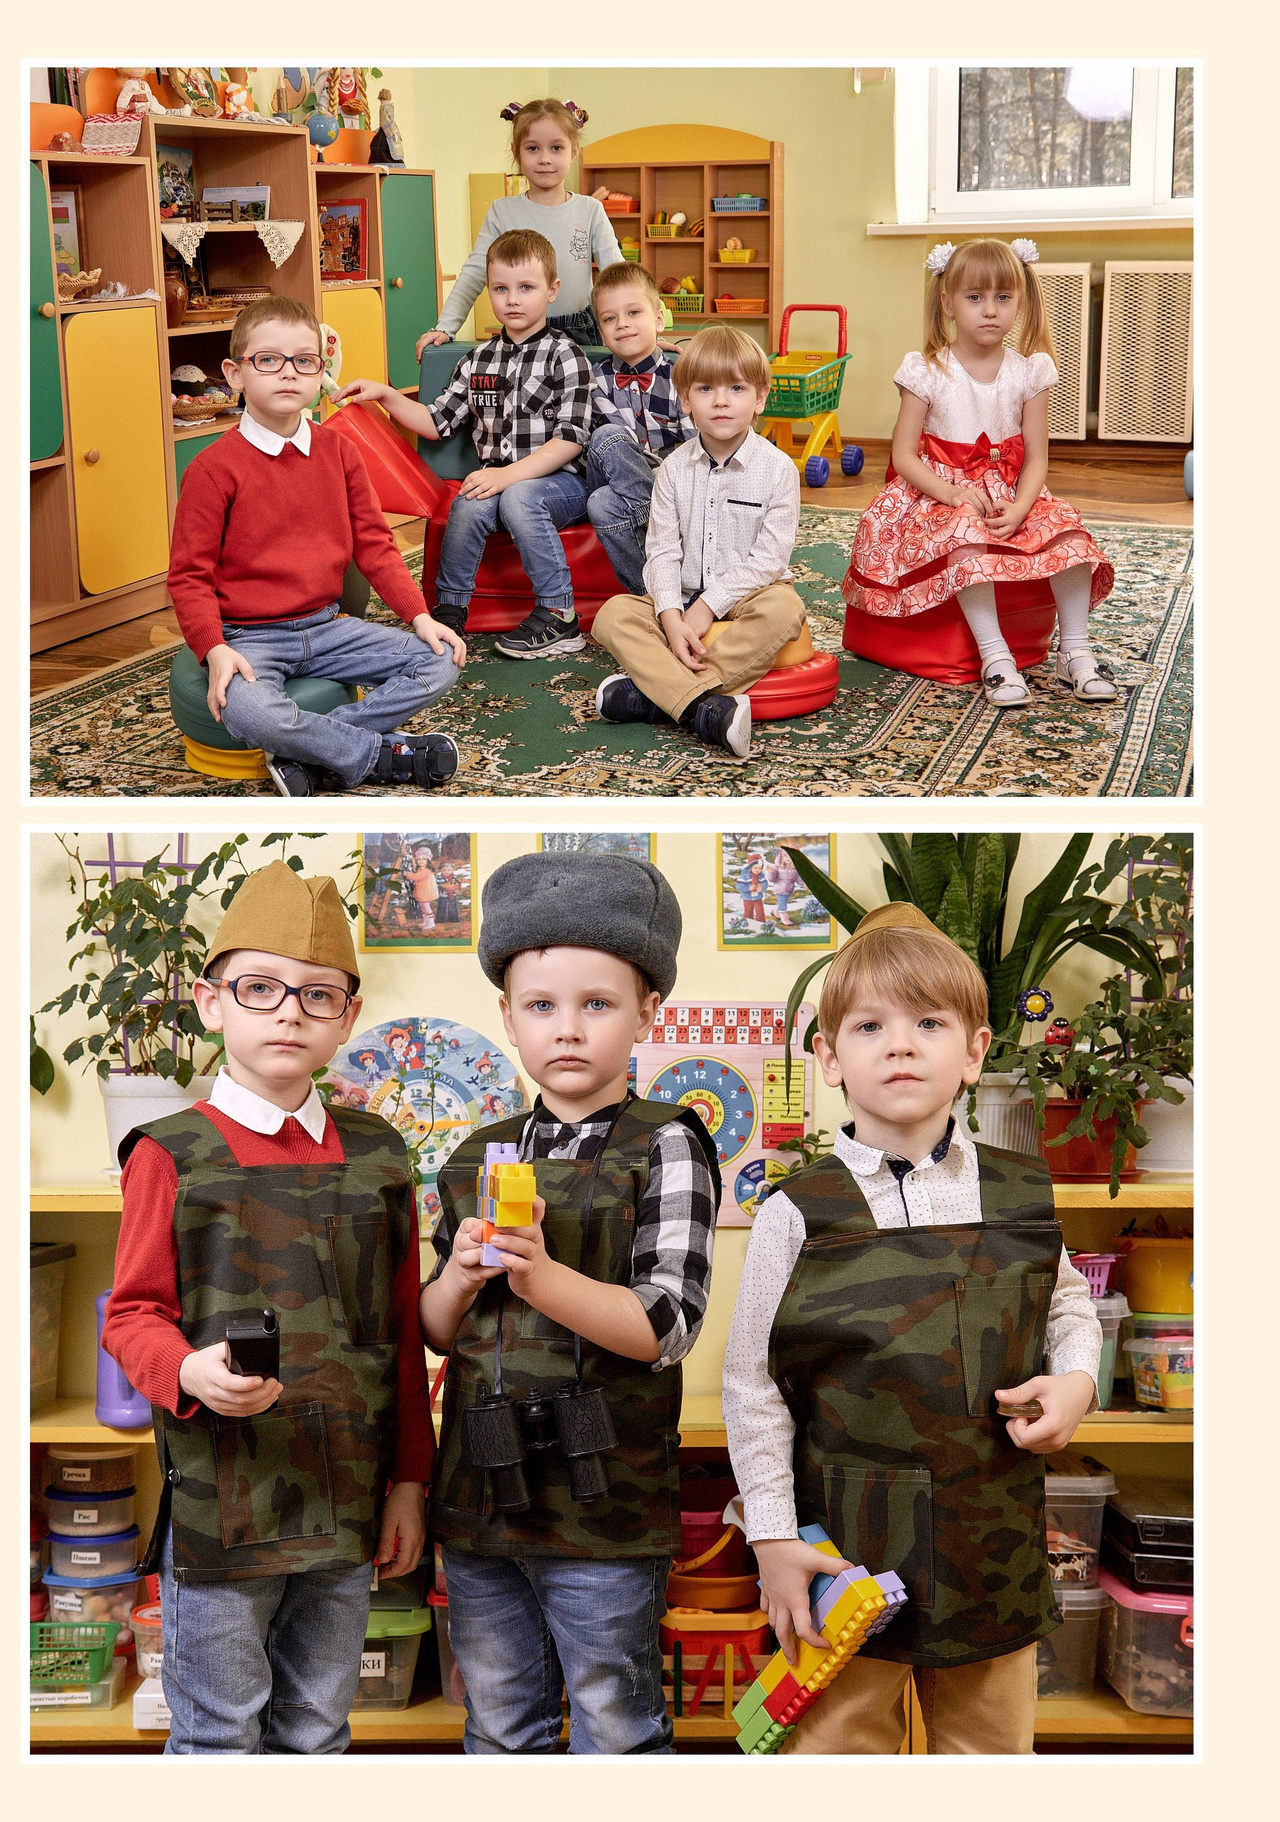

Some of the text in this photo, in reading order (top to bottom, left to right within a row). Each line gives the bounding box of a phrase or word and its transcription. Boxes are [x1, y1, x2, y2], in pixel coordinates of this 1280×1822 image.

[471, 376, 498, 389] STAY
[472, 394, 498, 407] TRUE
[693, 1070, 707, 1079] 12
[674, 1075, 687, 1084] 11
[716, 1077, 723, 1086] 1
[410, 1088, 423, 1098] 12
[659, 1090, 672, 1099] 10
[730, 1090, 738, 1099] 2
[445, 1098, 453, 1108] 2
[735, 1110, 743, 1119] 3
[452, 1131, 460, 1141] 4
[729, 1128, 736, 1136] 4
[444, 1146, 451, 1156] 5
[428, 1155, 435, 1164] 6
[63, 1470, 86, 1479] Гречка
